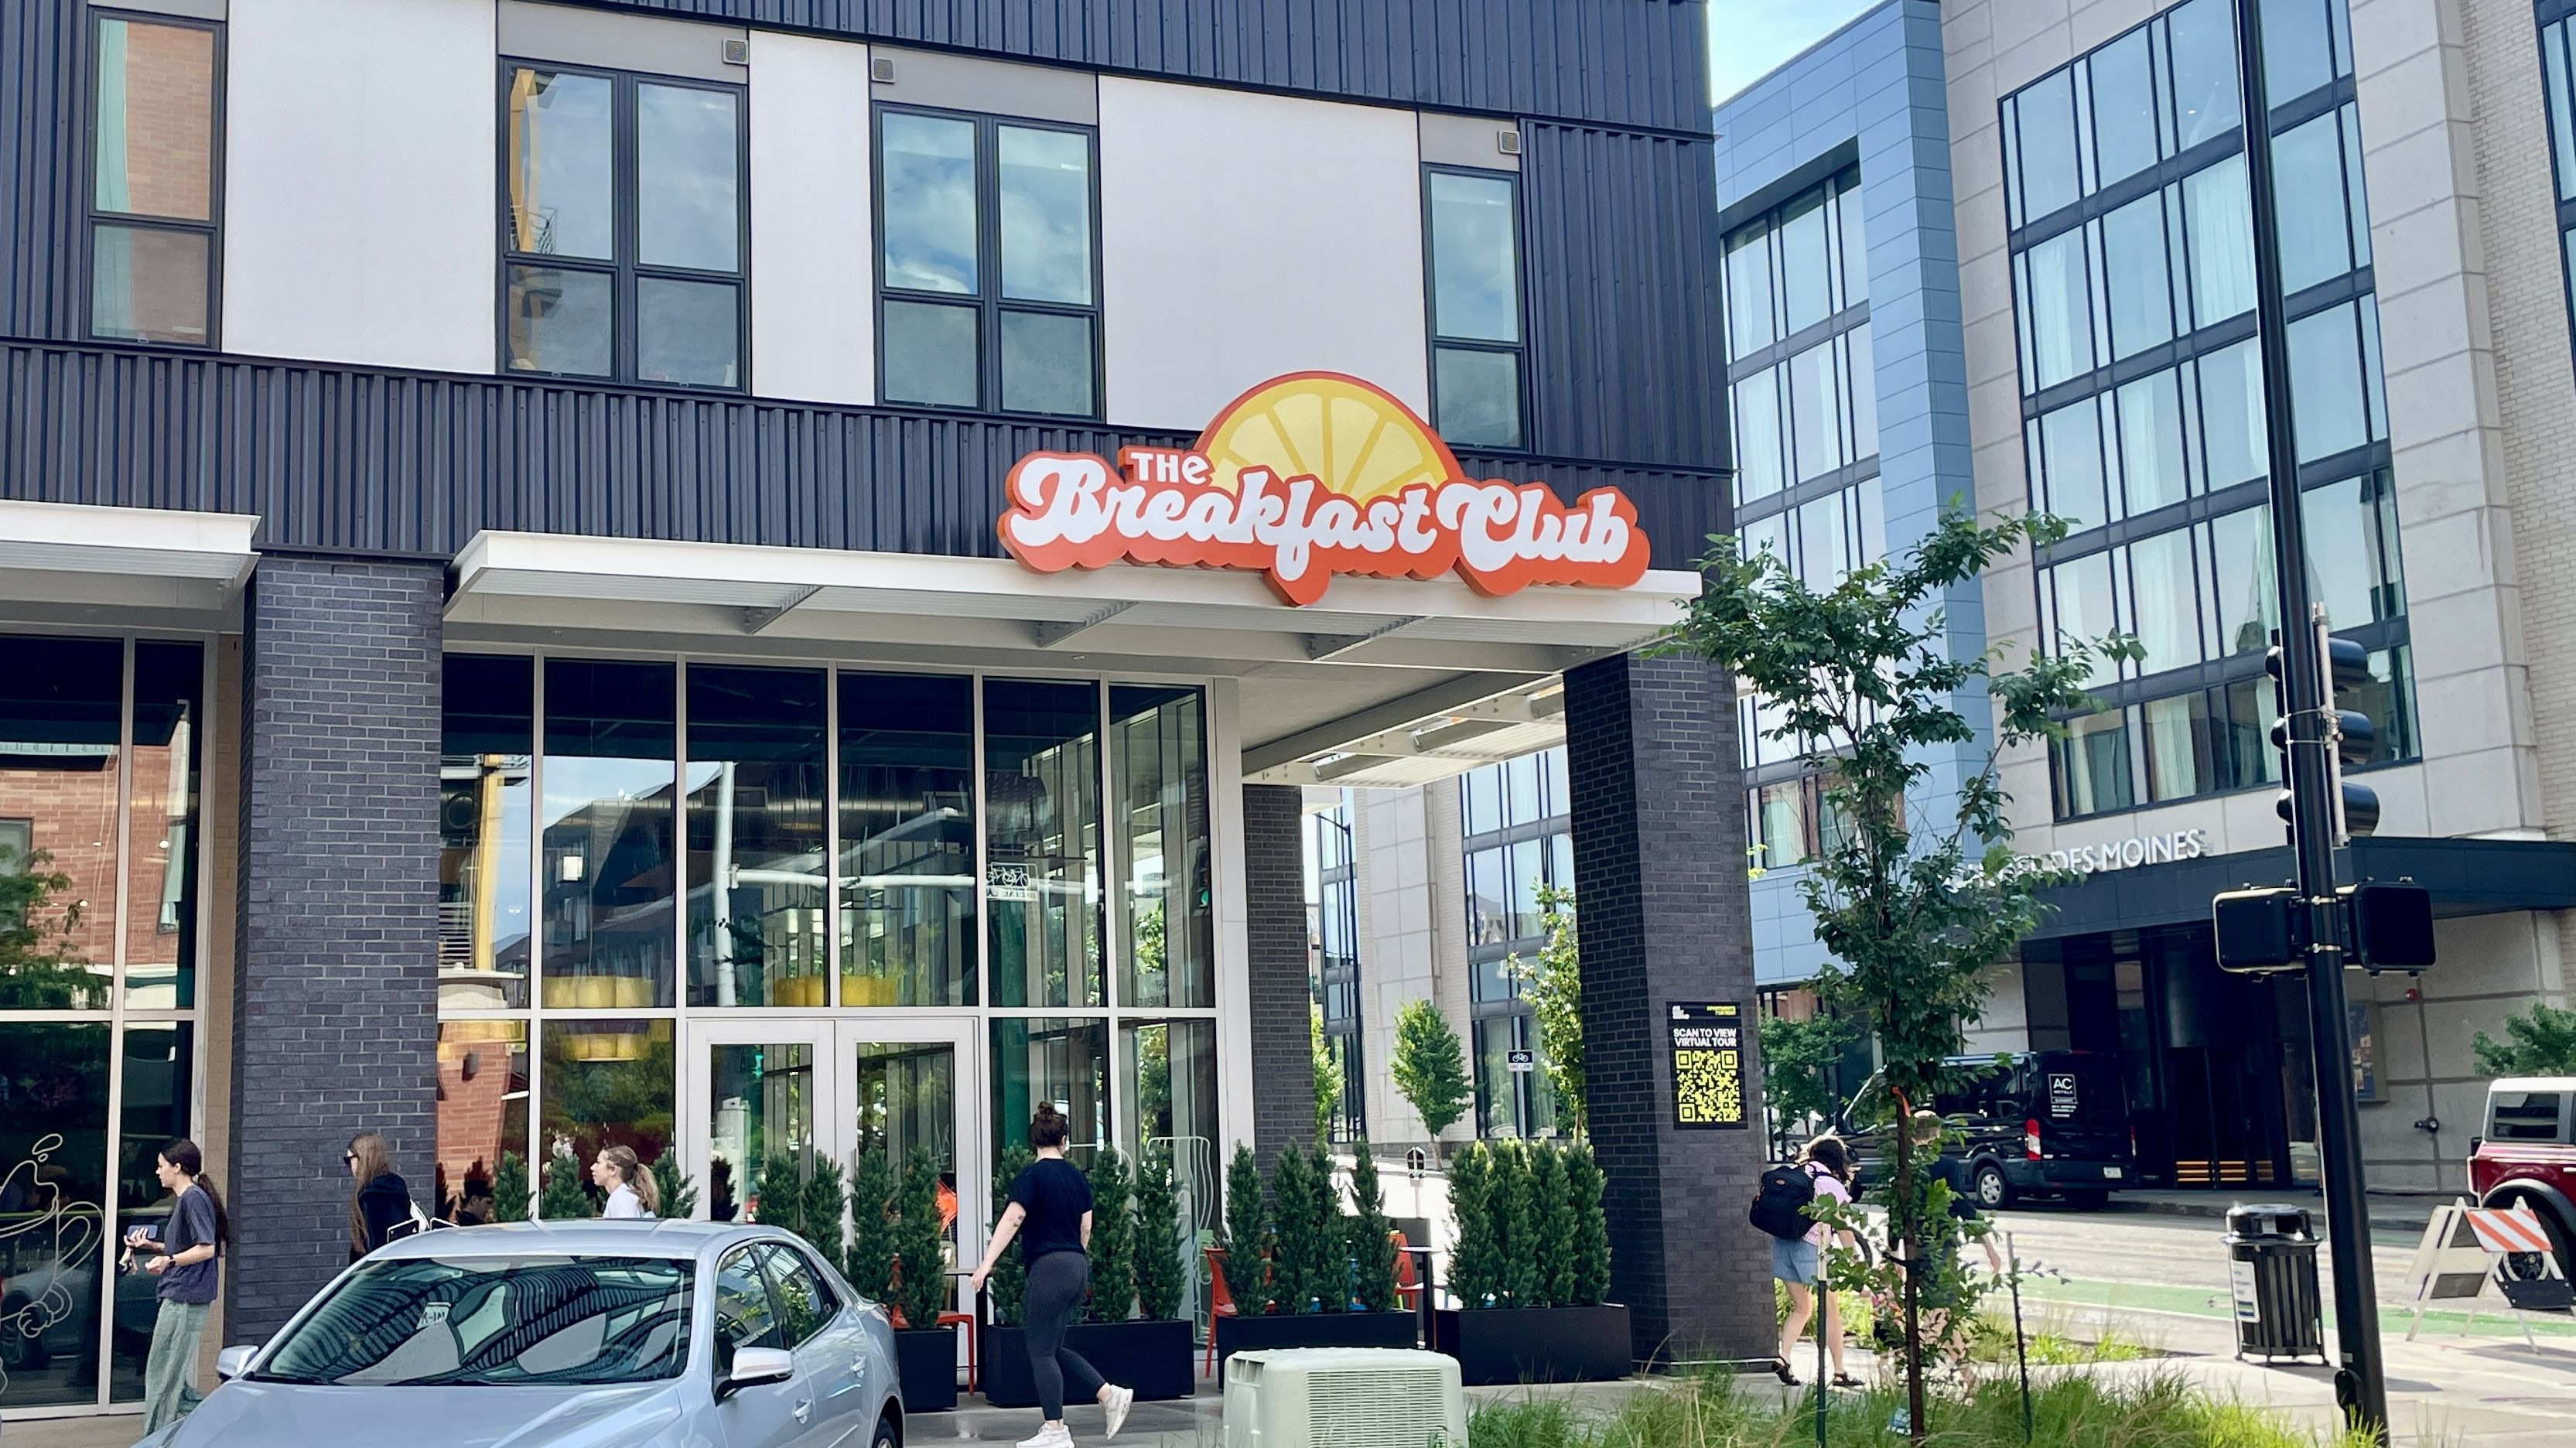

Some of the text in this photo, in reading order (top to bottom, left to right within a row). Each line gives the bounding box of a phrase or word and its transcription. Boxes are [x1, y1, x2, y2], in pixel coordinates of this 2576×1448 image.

[1010, 458, 1629, 582] Breakfast Club
[2051, 845, 2094, 876] DES
[2099, 828, 2202, 873] MOINES
[1672, 1028, 1737, 1038] SCAN TO VIEW
[1674, 1036, 1737, 1047] VIRTUAL TOUR
[2053, 1077, 2072, 1090] AC
